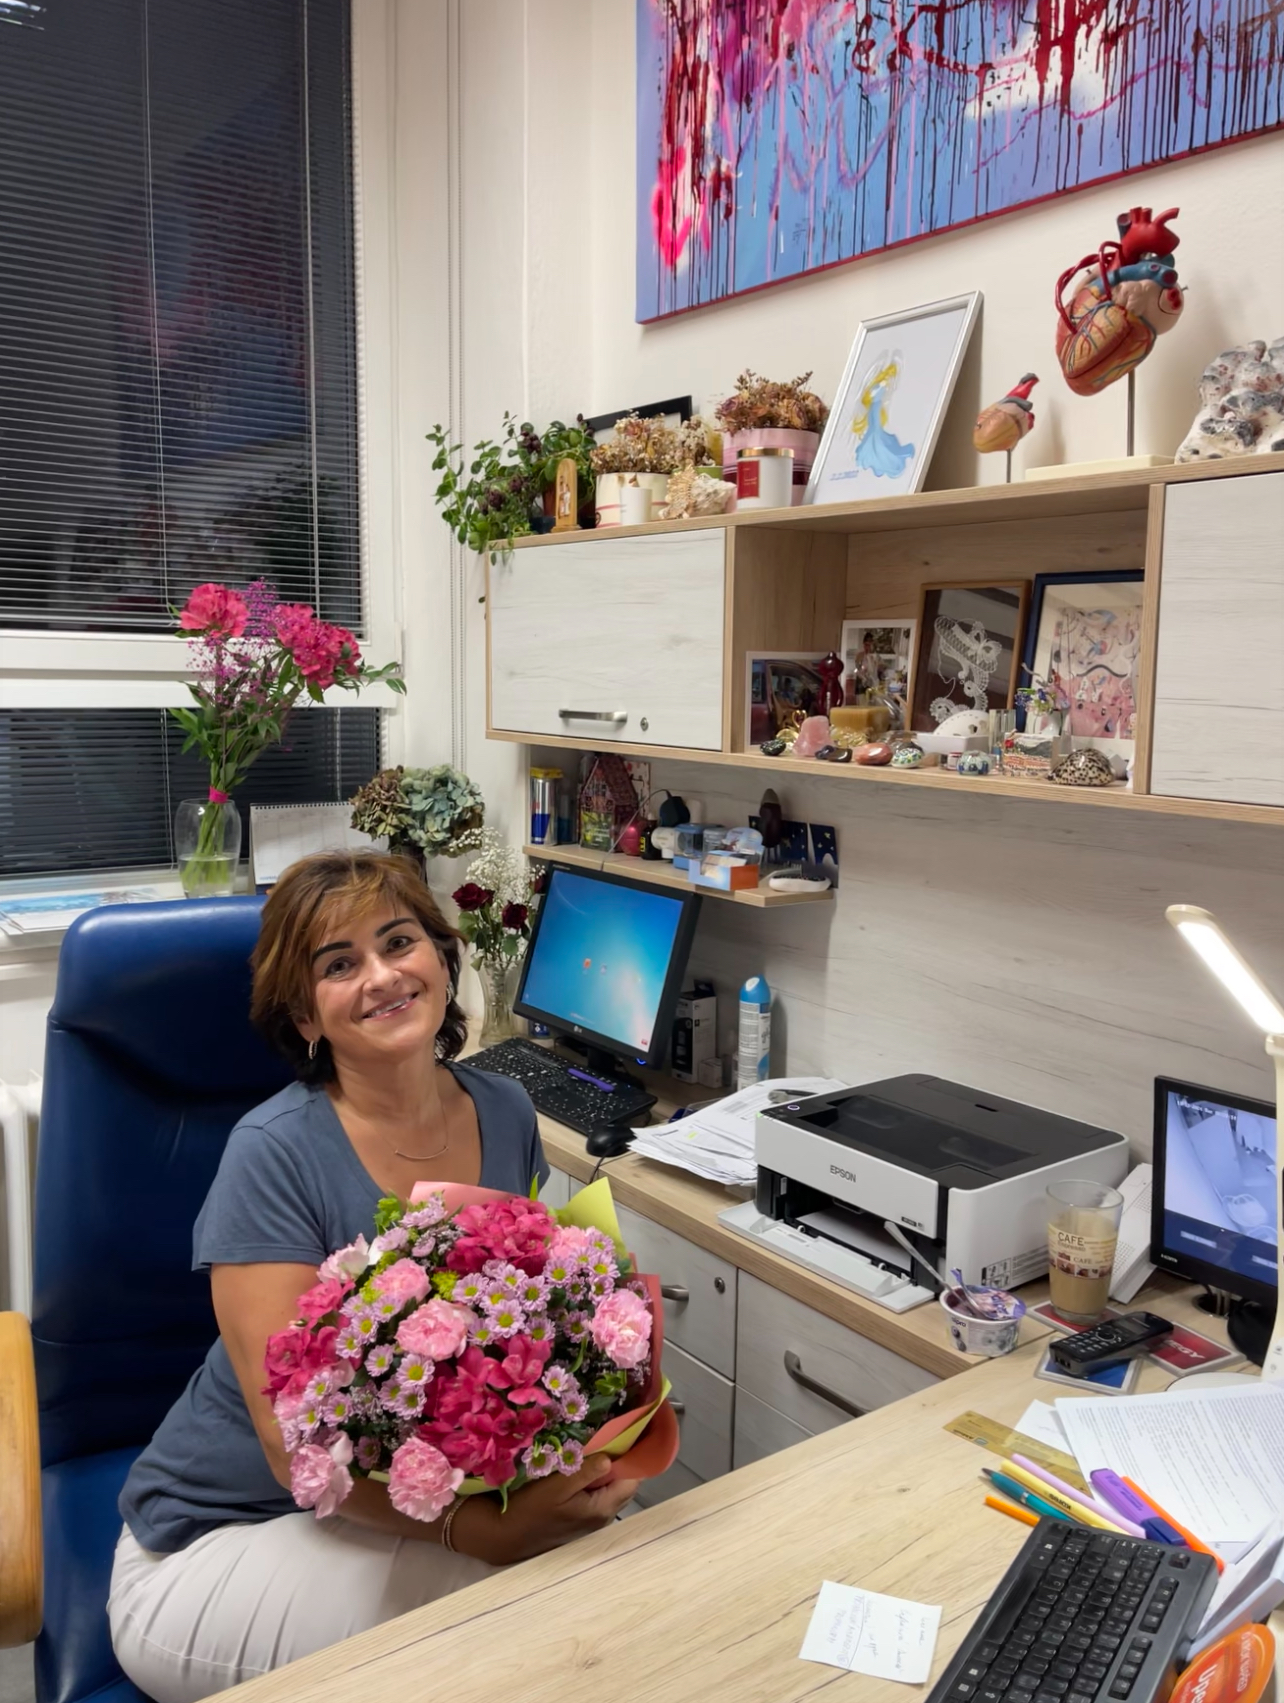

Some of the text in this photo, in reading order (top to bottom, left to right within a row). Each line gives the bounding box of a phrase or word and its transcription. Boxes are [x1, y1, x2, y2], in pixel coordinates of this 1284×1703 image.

[830, 1164, 856, 1183] EPSON
[1058, 1232, 1084, 1247] CAFE
[1190, 1663, 1218, 1703] Upe
